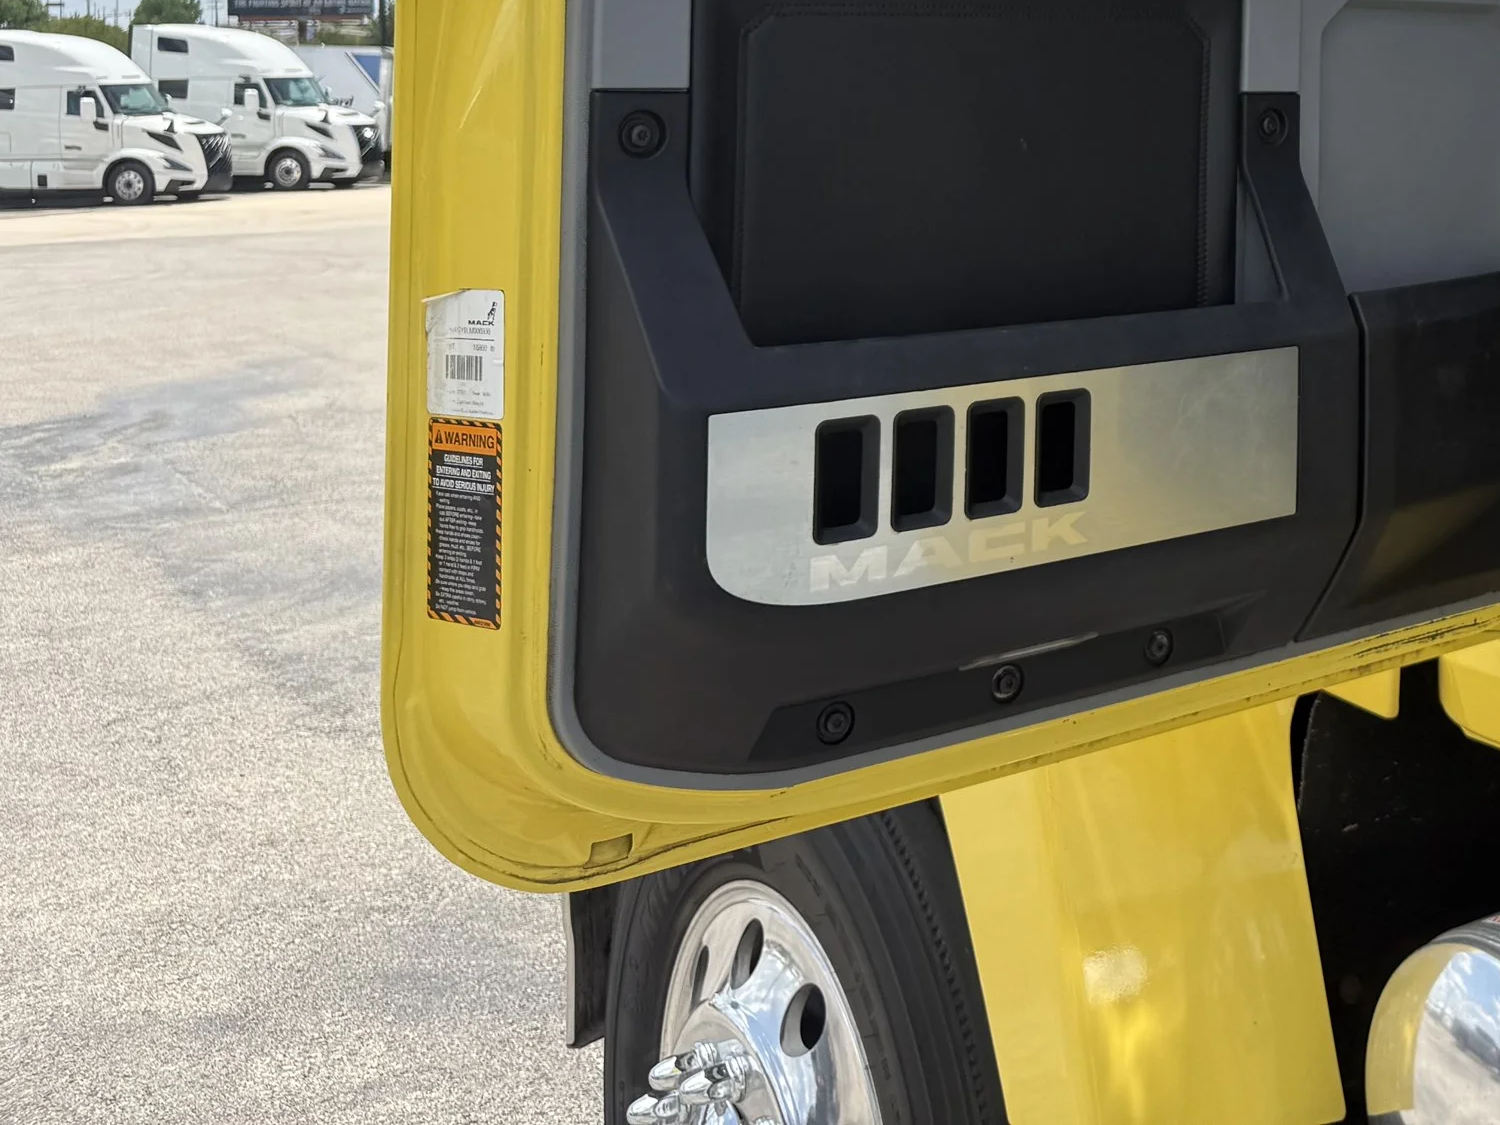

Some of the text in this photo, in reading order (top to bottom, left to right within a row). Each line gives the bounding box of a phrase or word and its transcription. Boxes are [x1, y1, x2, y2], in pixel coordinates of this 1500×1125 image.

[445, 430, 494, 449] WARNING
[444, 453, 483, 466] GUIDELINES FOR
[436, 465, 491, 479] ENTERING AND EXITING
[440, 478, 454, 487] AVOID
[455, 480, 476, 490] SERIOUS
[477, 482, 494, 492] INJURY
[809, 510, 1088, 592] MACK
